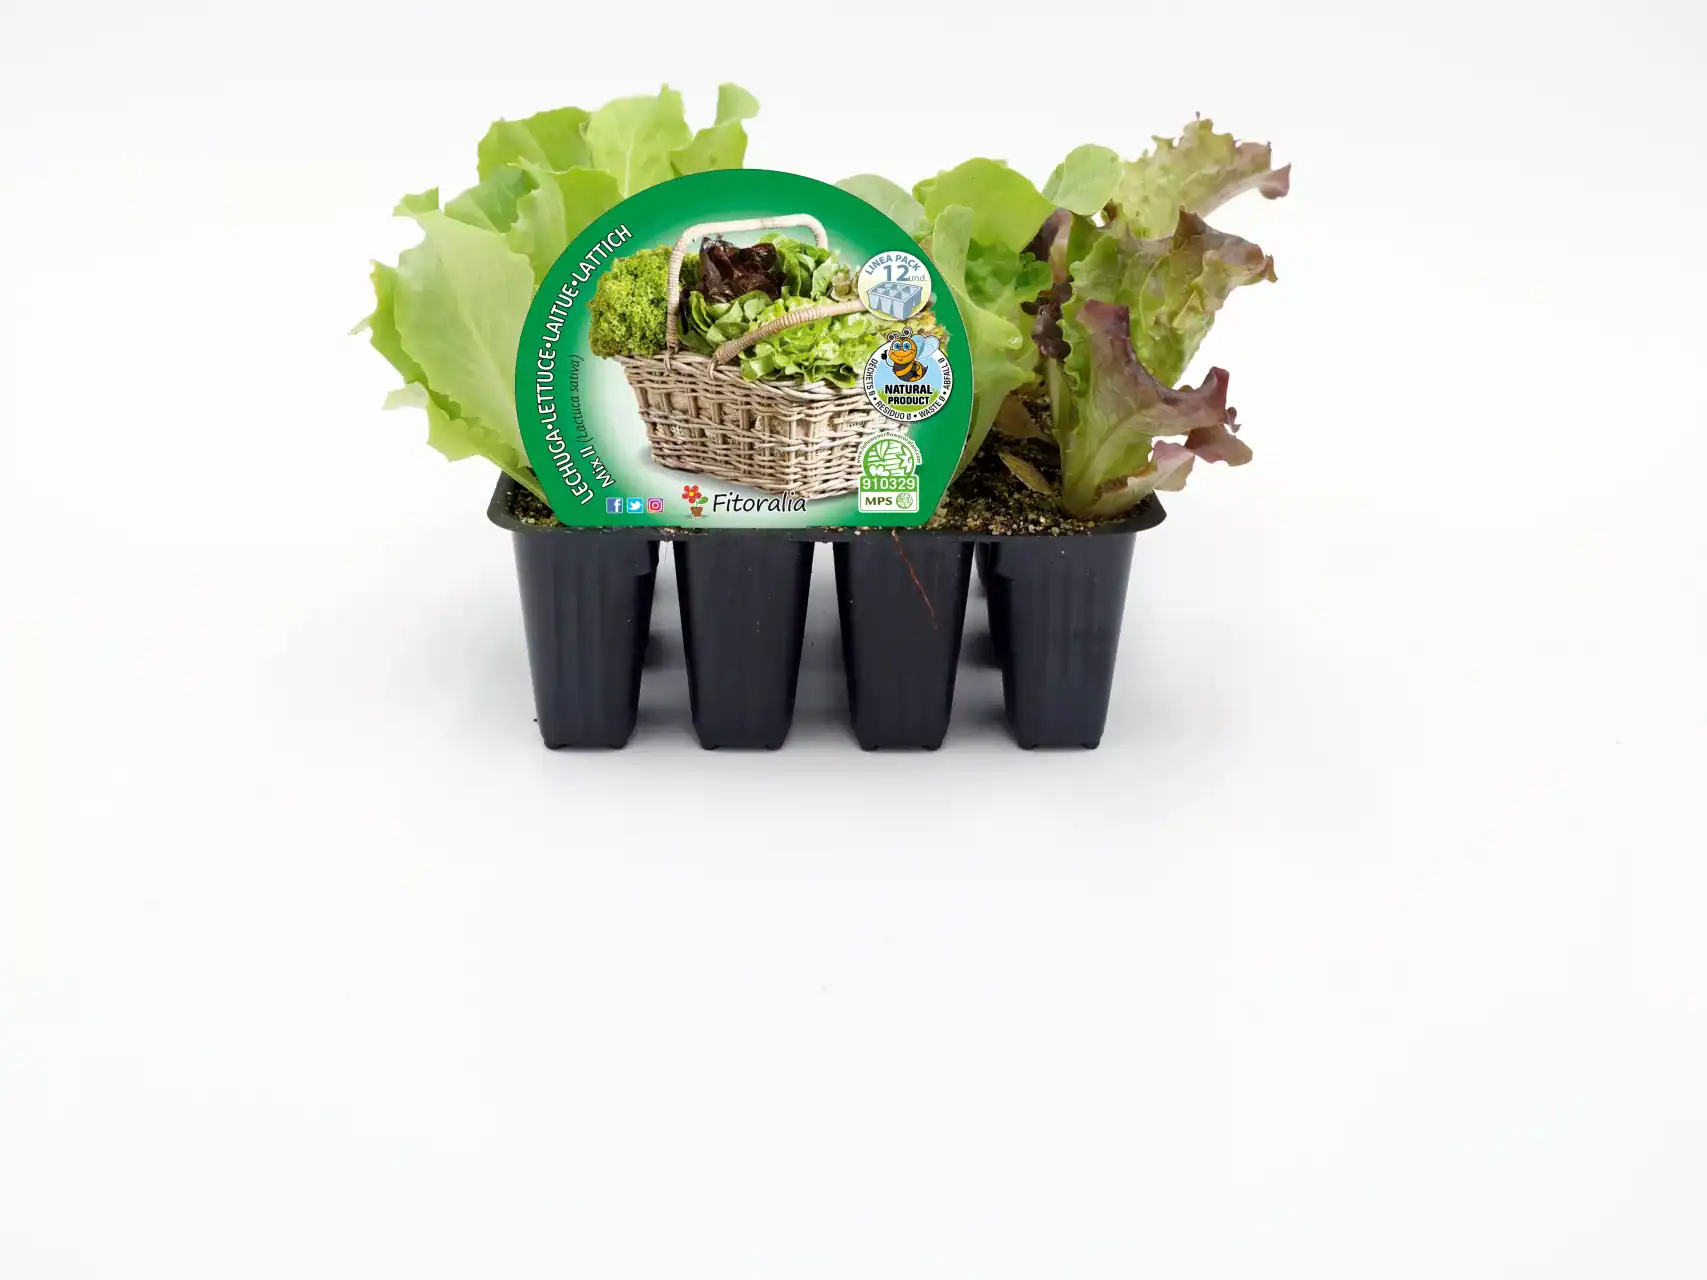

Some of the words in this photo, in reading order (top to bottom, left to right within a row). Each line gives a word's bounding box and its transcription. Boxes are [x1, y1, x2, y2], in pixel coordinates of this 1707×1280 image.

[571, 224, 633, 282] LATTICH
[865, 254, 893, 275] LINEA
[895, 254, 921, 272] PACK
[883, 264, 910, 282] 12
[542, 284, 579, 342] LAITUE
[536, 348, 557, 424] LETTUCE
[875, 400, 905, 419] RESIDUO
[918, 403, 940, 418] WASTE
[942, 362, 951, 391] ABFALL
[884, 384, 933, 395] NATURAL
[887, 396, 930, 405] PRODUCT
[545, 429, 594, 505] LECHUGA
[590, 456, 616, 488] Mix
[862, 477, 916, 490] 910329
[712, 491, 808, 513] Fitoralia
[865, 496, 893, 506] MPS
